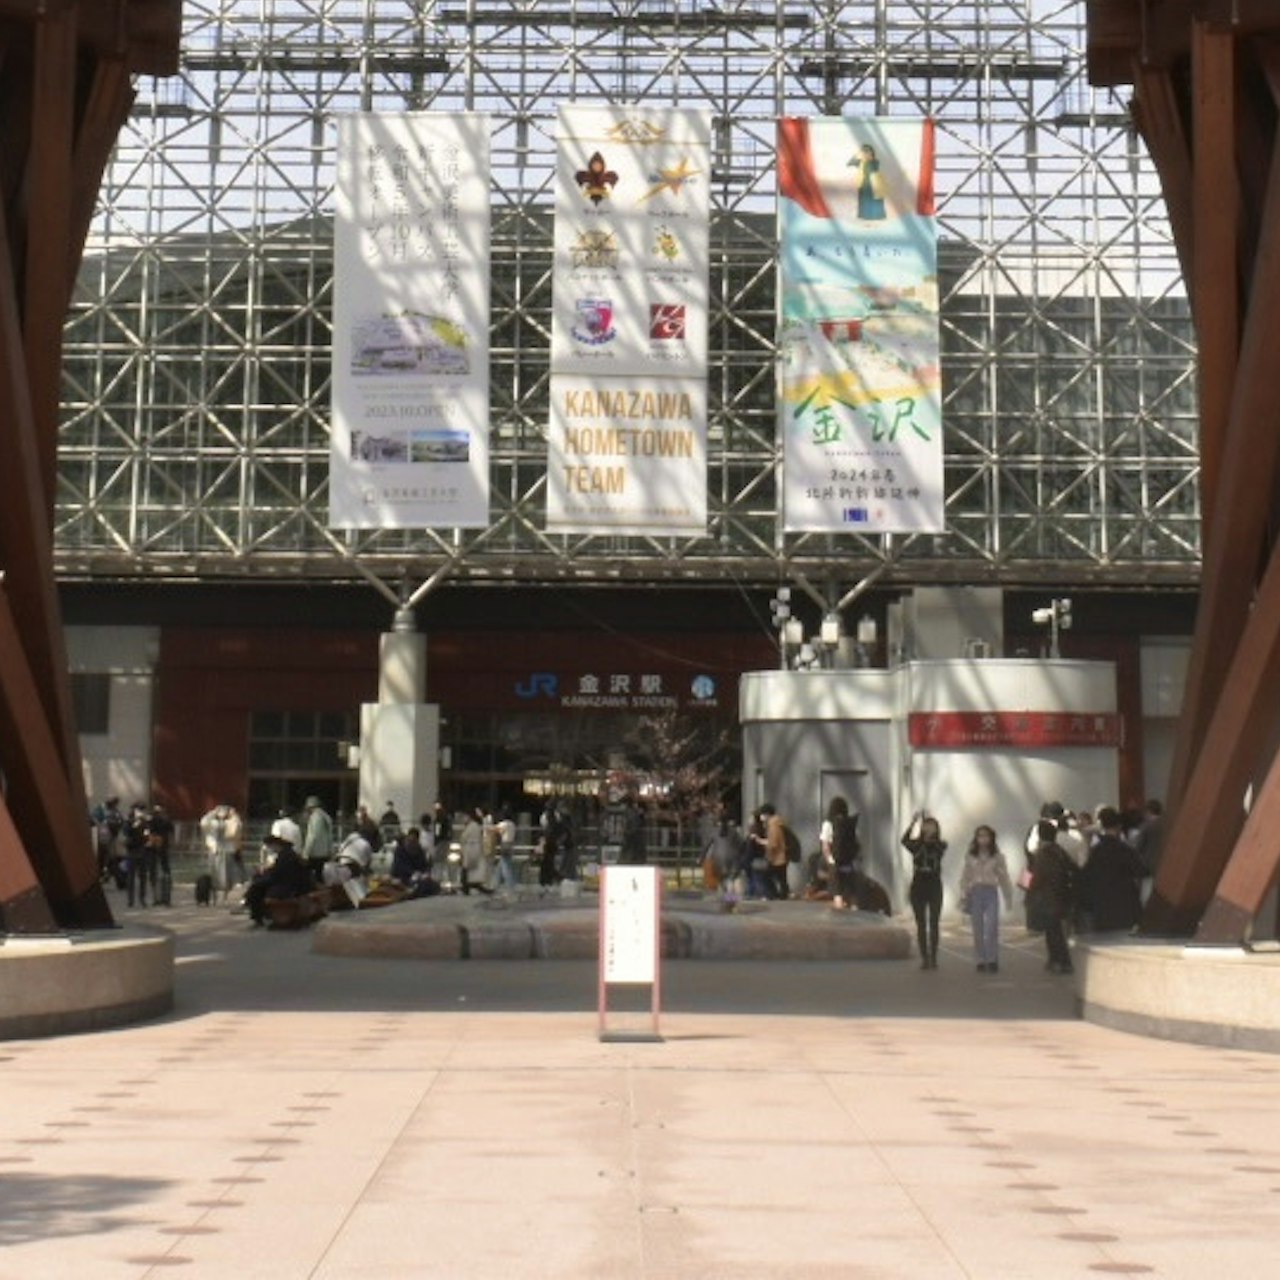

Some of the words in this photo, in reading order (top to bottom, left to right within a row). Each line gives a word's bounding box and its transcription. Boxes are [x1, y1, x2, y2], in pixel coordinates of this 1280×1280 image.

[565, 390, 693, 420] KANAZAWA
[793, 386, 932, 445] 金沢
[564, 428, 694, 458] HOMETOWN
[563, 465, 625, 494] TEAM
[514, 673, 558, 698] JR
[578, 673, 663, 694] 金沢駅
[561, 695, 629, 708] KANAZAWA
[631, 695, 677, 708] STATION
